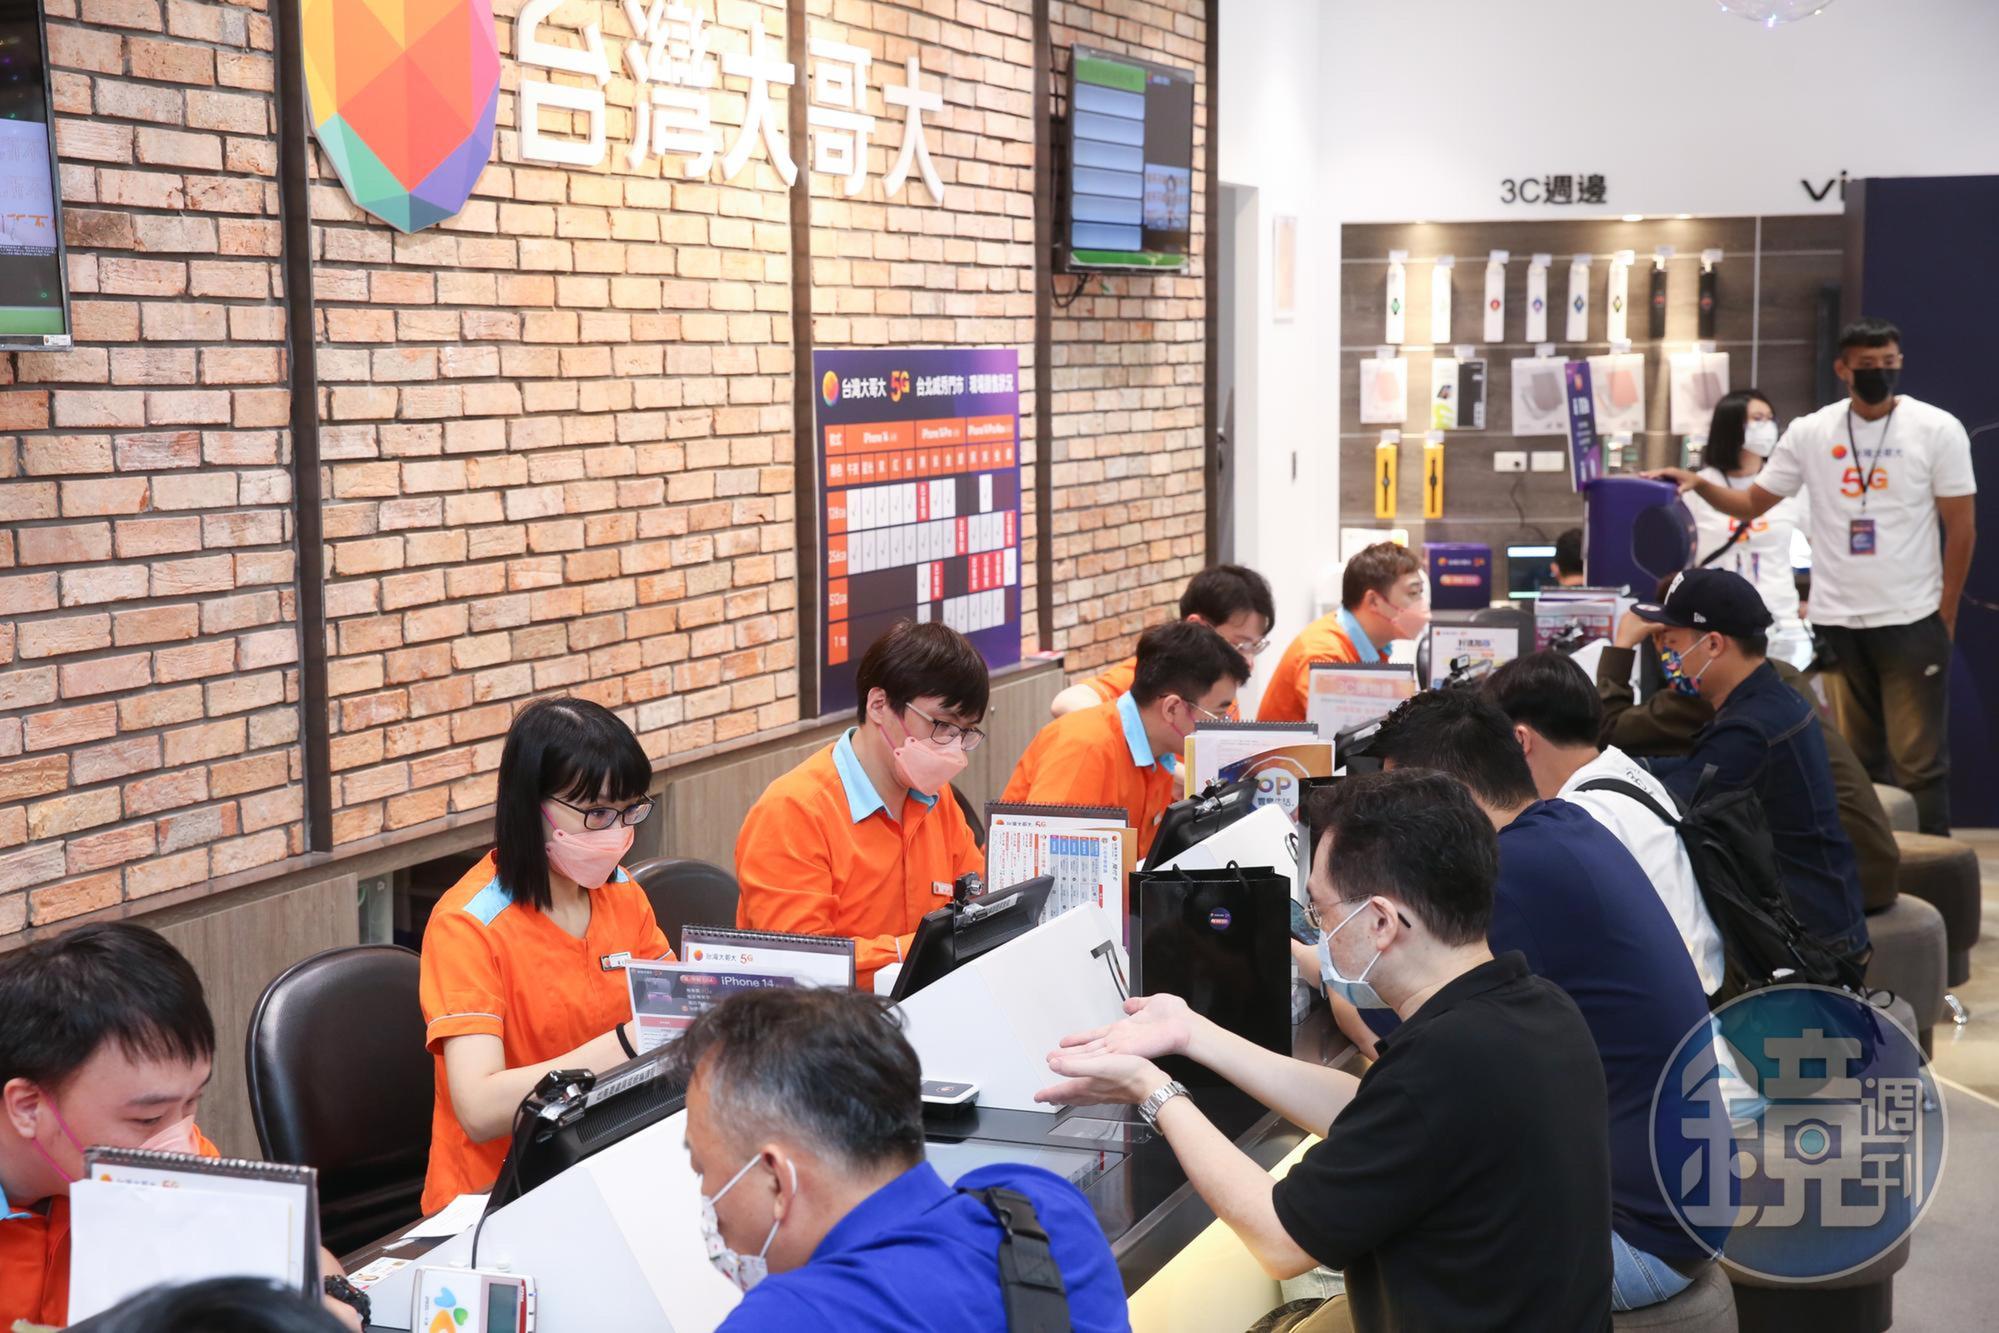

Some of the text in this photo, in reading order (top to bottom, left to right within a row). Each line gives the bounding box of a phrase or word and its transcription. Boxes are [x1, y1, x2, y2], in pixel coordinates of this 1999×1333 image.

[517, 0, 944, 203] 台灣大哥大
[1500, 175, 1607, 204] 3C週邊
[841, 377, 887, 399] 台灣大哥大
[890, 370, 910, 402] 5G
[1840, 467, 1888, 498] 5G
[740, 953, 753, 965] 5G
[721, 976, 760, 988] iPhone
[762, 978, 774, 988] 14
